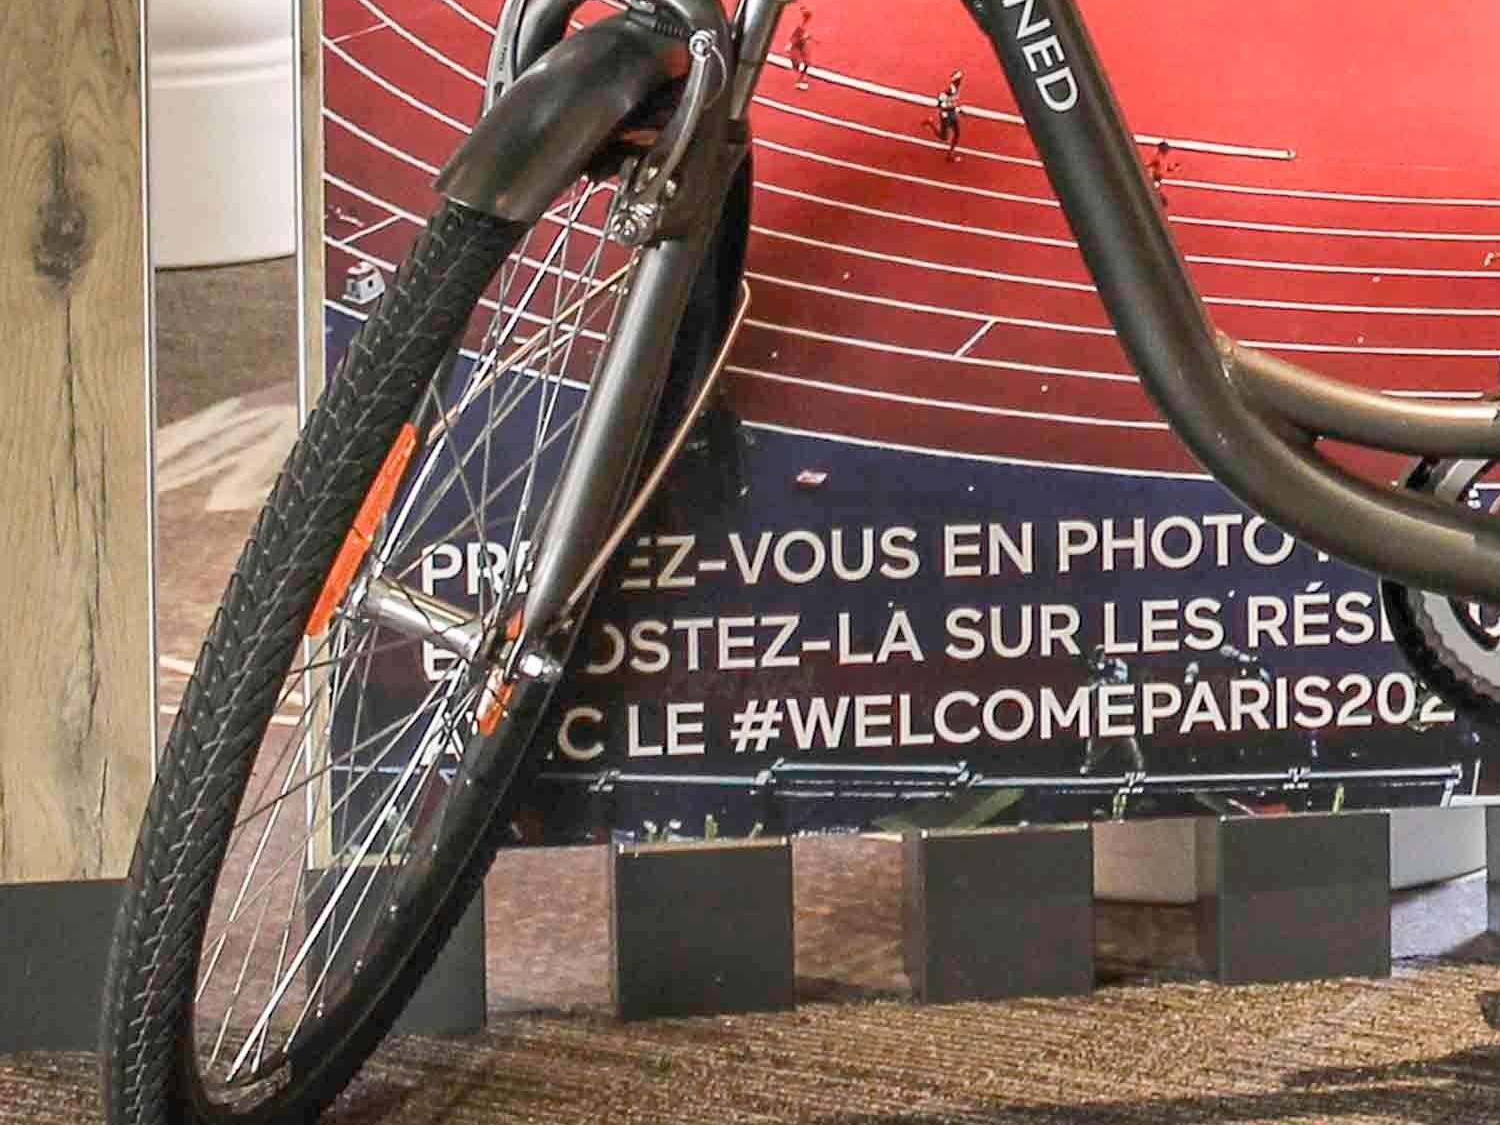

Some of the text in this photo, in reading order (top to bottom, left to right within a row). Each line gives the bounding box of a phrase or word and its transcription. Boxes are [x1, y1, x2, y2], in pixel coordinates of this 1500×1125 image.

[944, 521, 1034, 577] EN
[1058, 514, 1295, 573] PHOTO
[586, 610, 924, 675] OSTEZ-LA
[945, 604, 1081, 660] SUR
[1104, 597, 1225, 655] LES
[627, 702, 706, 758] LE
